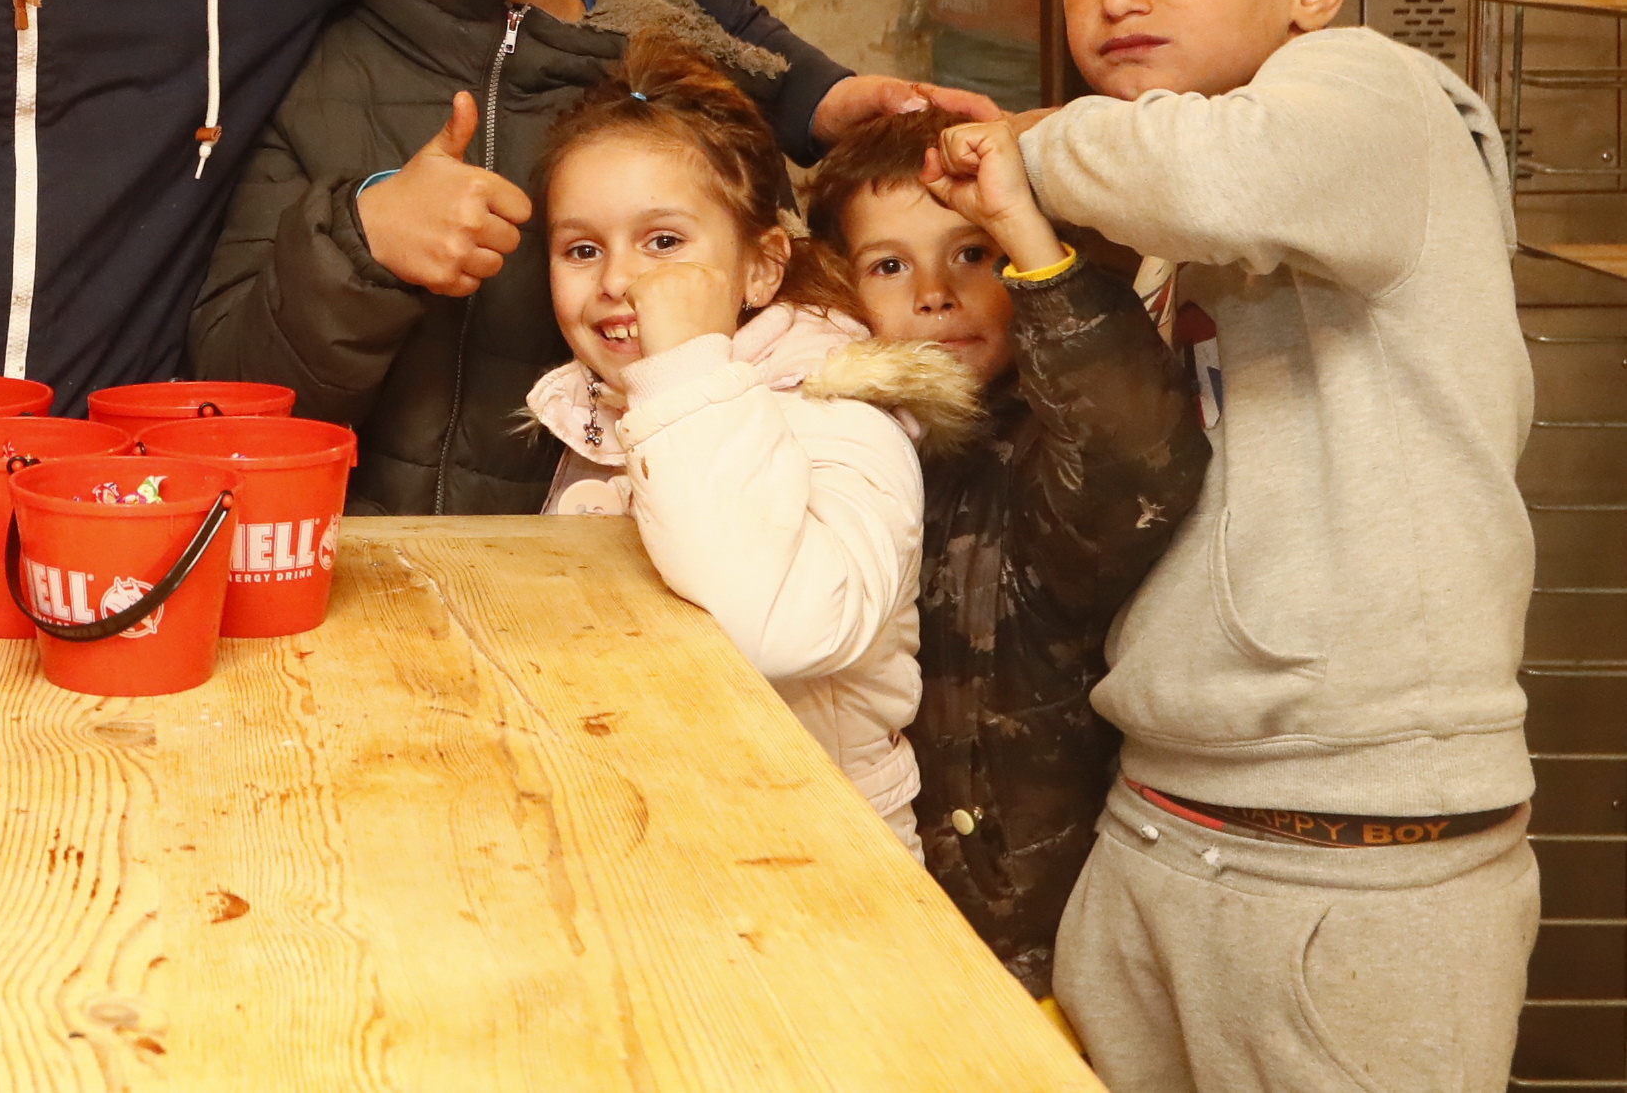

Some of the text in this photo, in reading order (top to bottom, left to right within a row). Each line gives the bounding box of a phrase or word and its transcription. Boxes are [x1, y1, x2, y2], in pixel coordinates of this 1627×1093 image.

[229, 569, 312, 583] ERGY DRINK
[1362, 821, 1450, 844] BOY
